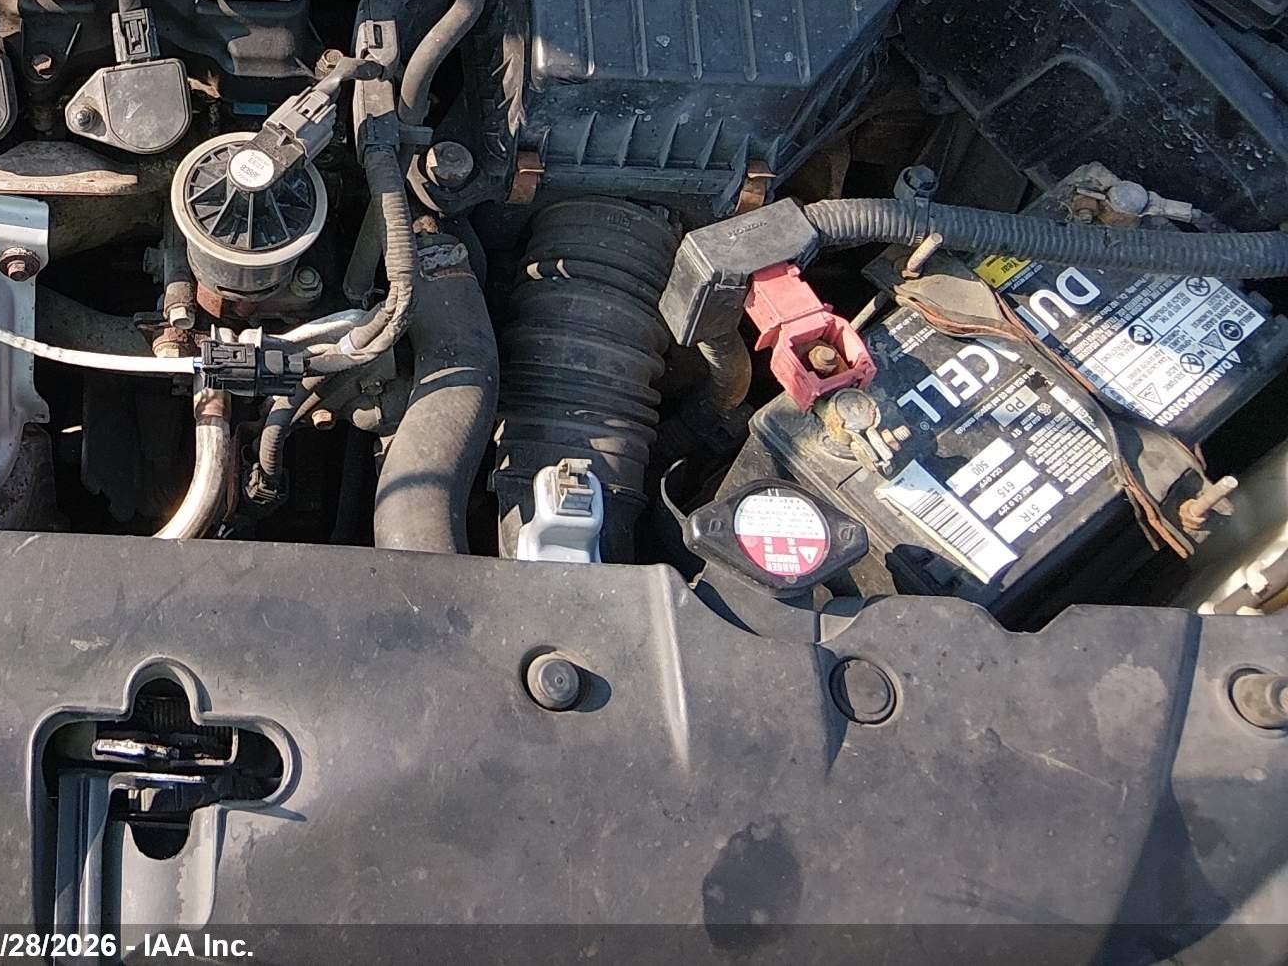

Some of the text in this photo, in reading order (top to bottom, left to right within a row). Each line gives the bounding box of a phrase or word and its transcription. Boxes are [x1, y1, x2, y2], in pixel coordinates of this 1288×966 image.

[998, 258, 1019, 275] Year
[1153, 358, 1232, 428] DANGER/POISON
[1002, 395, 1027, 416] Pb
[969, 458, 990, 476] 500
[994, 479, 1017, 498] 615
[1018, 502, 1042, 523] 51R
